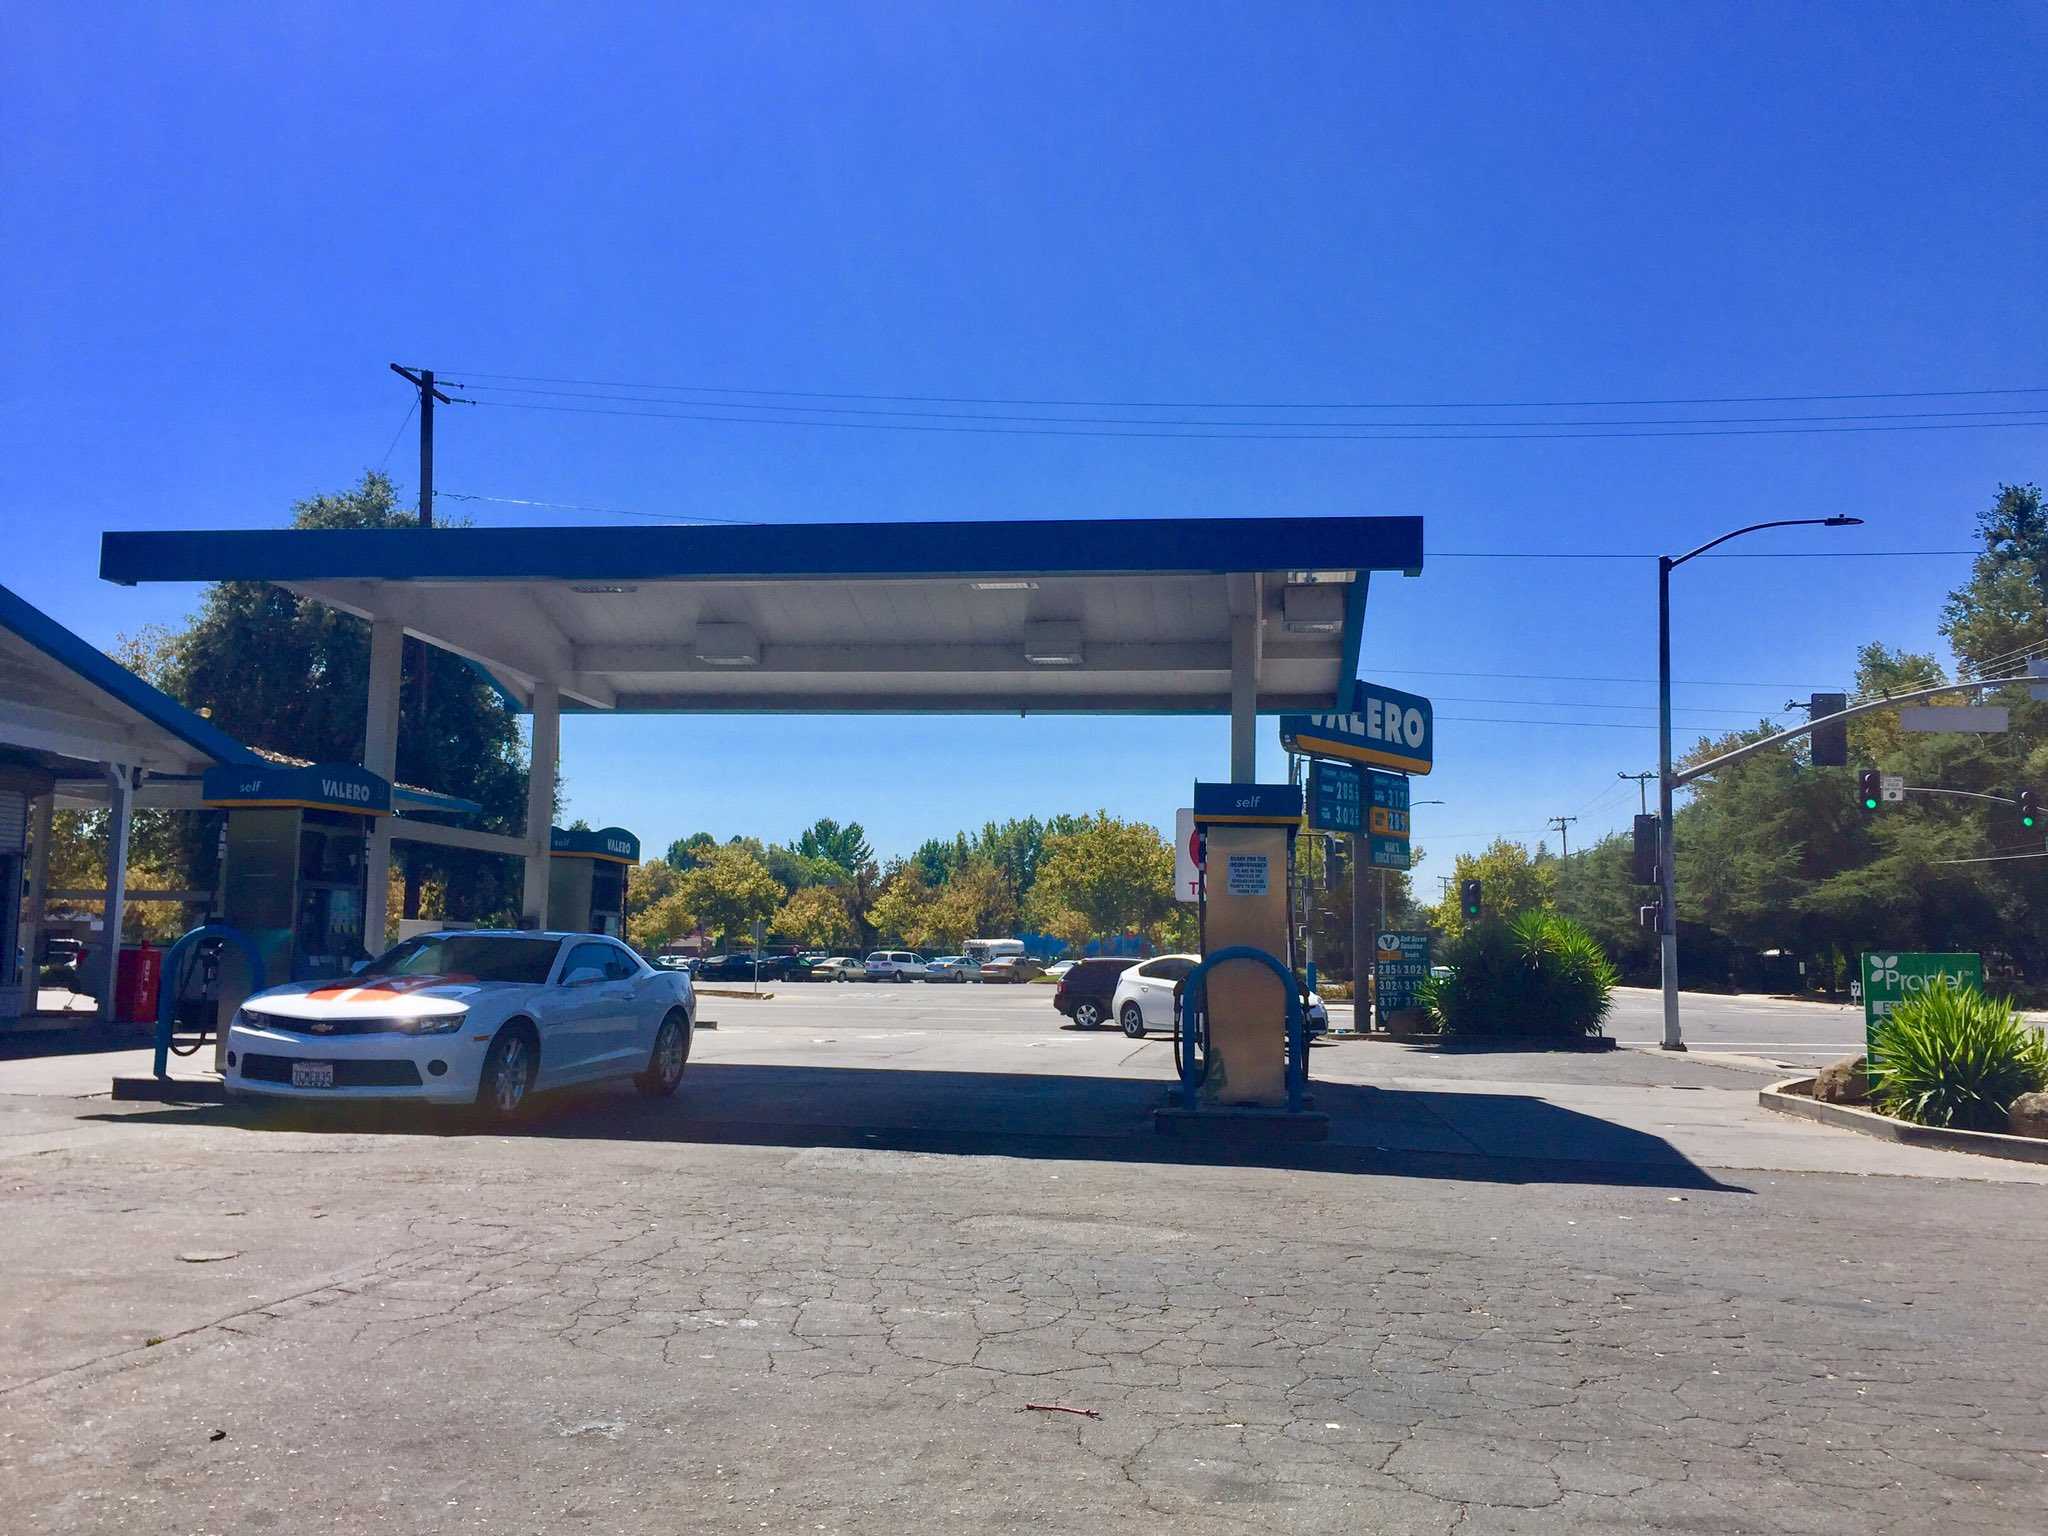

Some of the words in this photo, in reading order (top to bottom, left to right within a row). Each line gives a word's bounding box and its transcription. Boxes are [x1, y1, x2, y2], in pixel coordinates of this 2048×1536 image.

[240, 780, 262, 792] self
[322, 779, 370, 802] VALERO
[1235, 796, 1261, 808] self
[607, 839, 632, 855] VALERO
